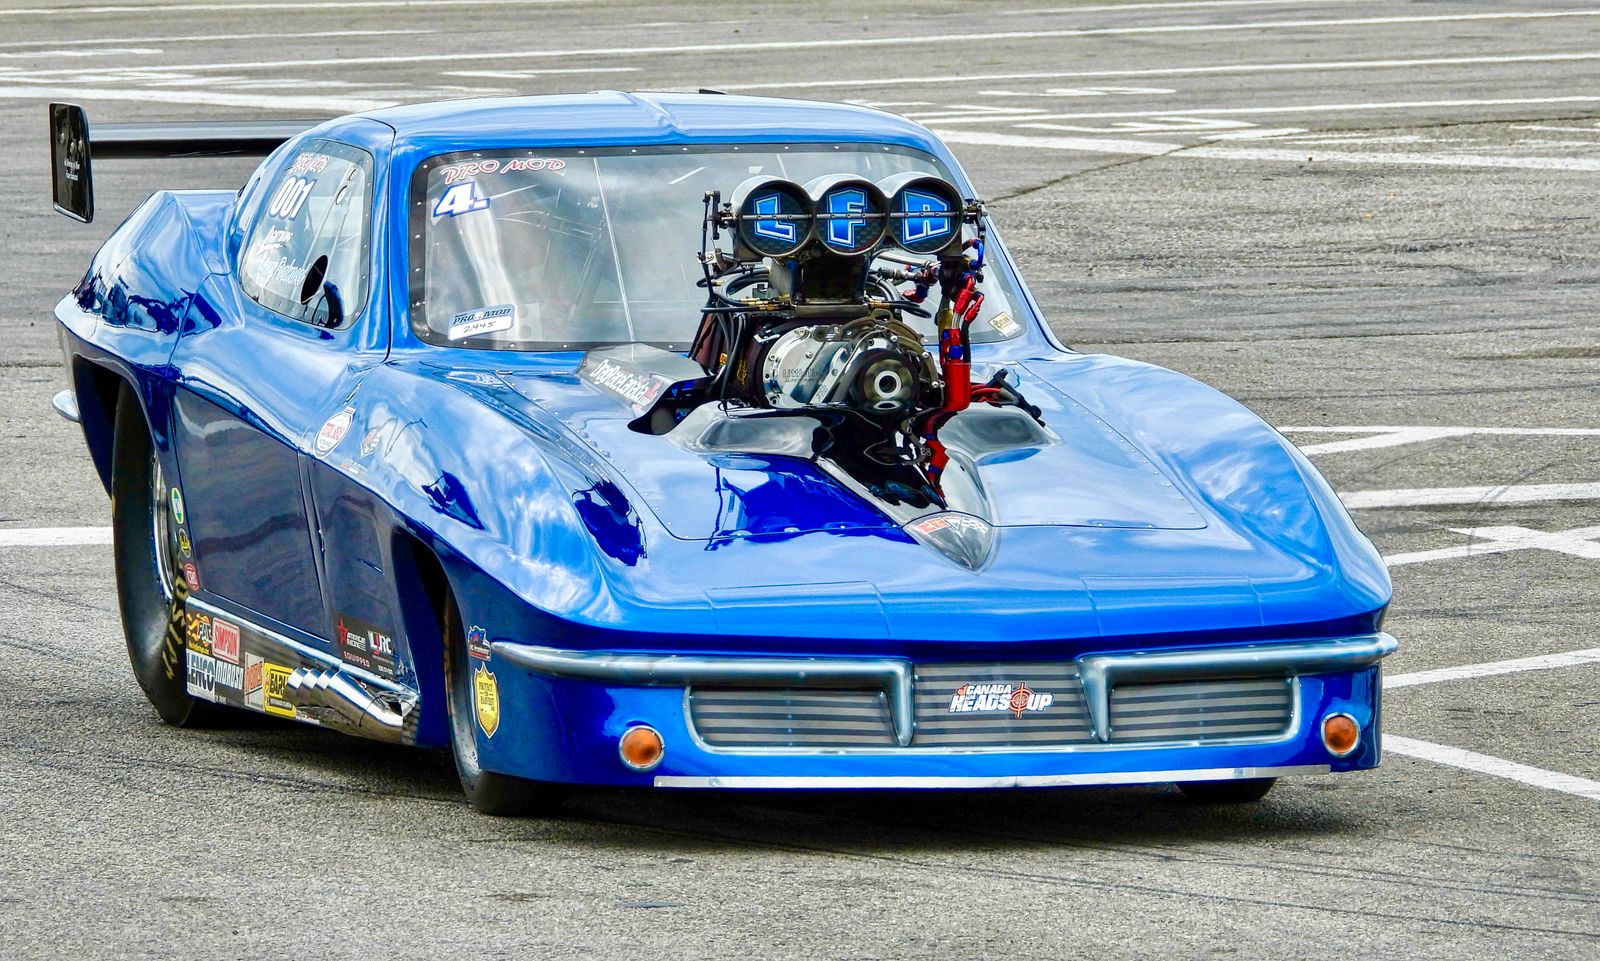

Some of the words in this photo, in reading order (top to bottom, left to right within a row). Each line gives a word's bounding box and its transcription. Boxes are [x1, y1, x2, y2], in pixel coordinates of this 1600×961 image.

[440, 159, 500, 184] PRO
[500, 158, 566, 174] MOD
[268, 174, 318, 221] 001
[452, 313, 475, 325] PRO
[483, 308, 511, 318] MOD
[463, 321, 497, 334] 2445
[214, 624, 238, 657] SIMPSON
[343, 651, 370, 668] EQUIPPED
[186, 652, 215, 692] LENCO
[215, 659, 244, 691] MOROSO
[966, 683, 1013, 695] CANADA
[950, 693, 1013, 713] HEADS
[1027, 693, 1054, 712] UP
